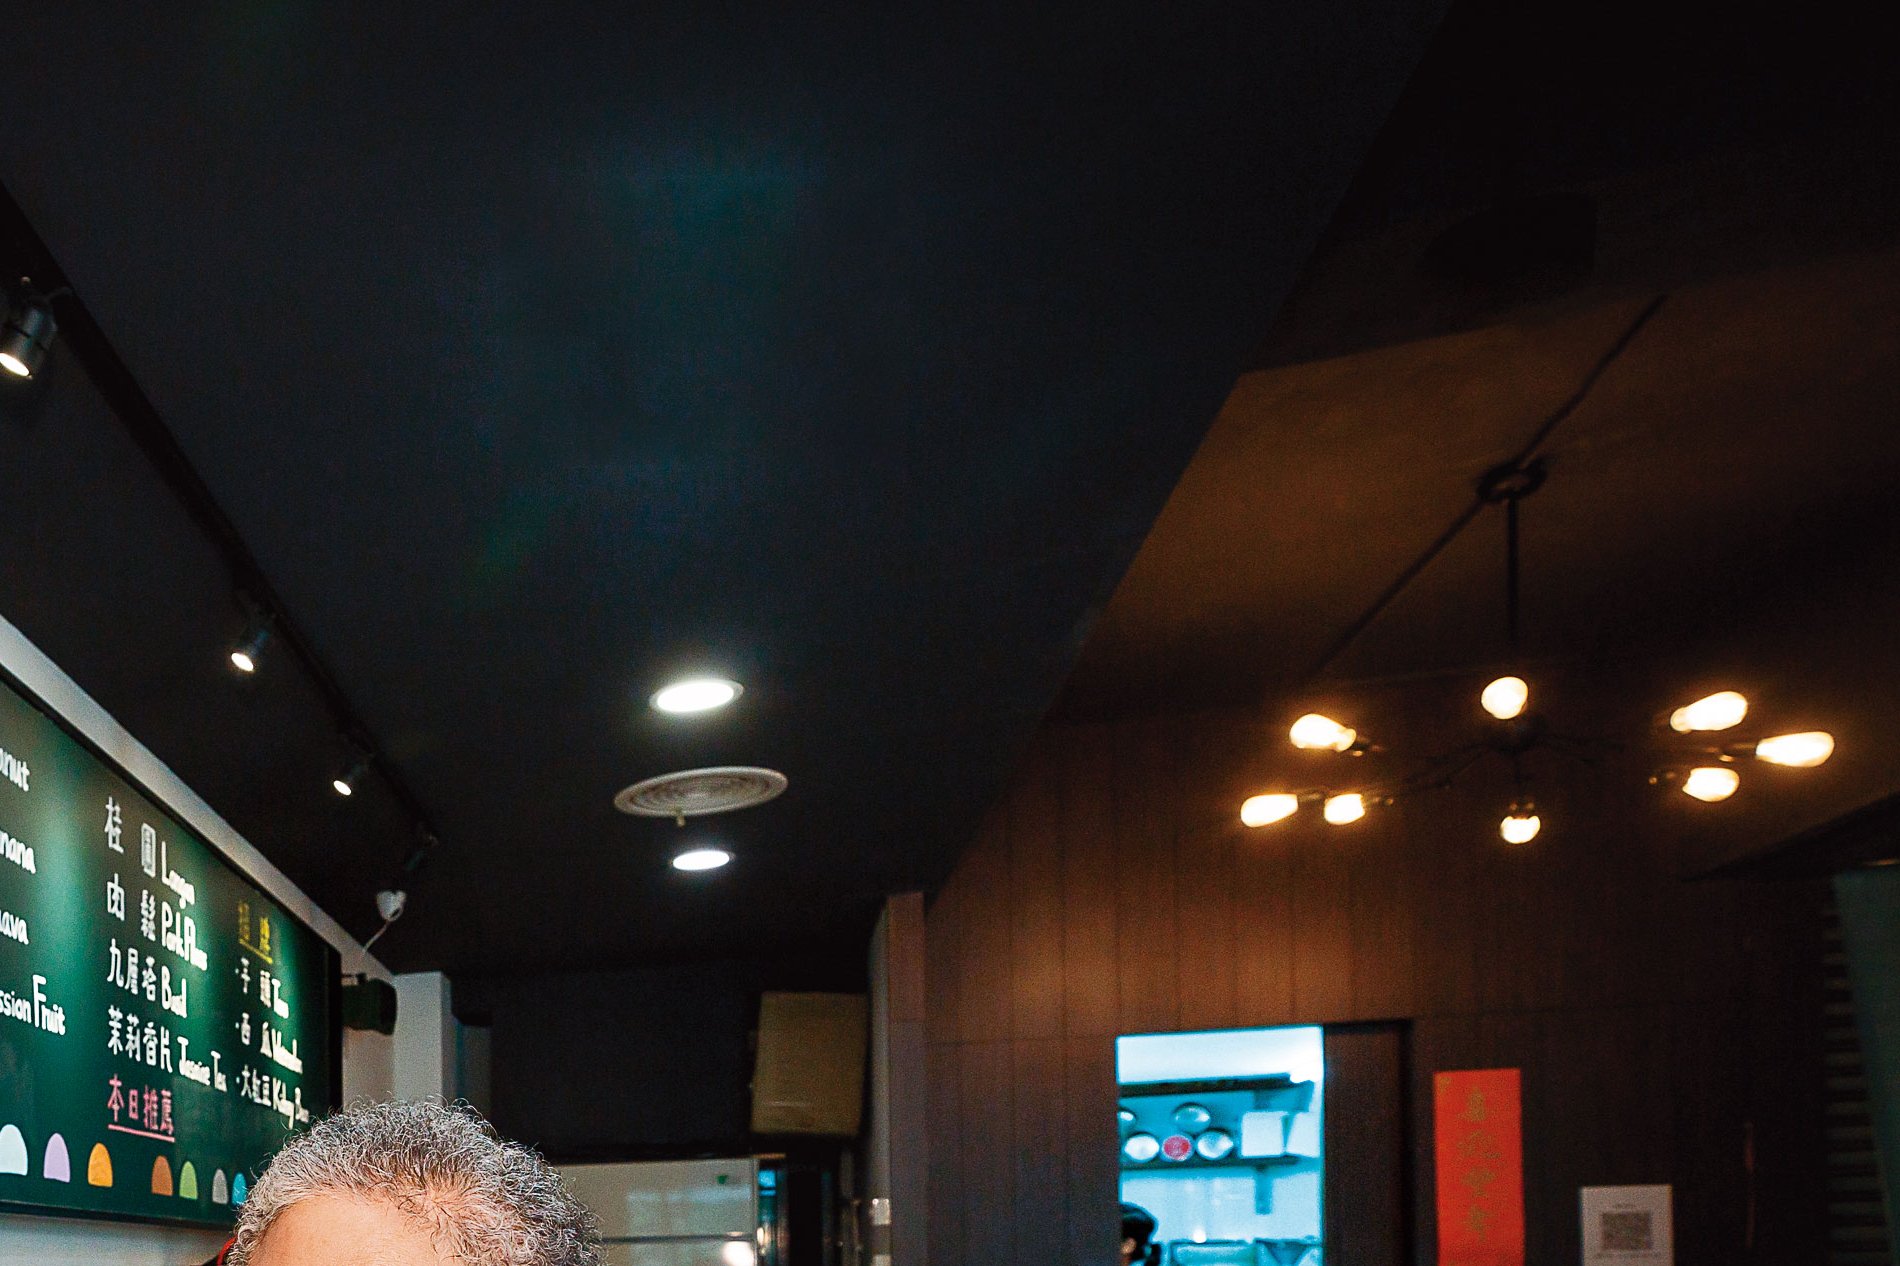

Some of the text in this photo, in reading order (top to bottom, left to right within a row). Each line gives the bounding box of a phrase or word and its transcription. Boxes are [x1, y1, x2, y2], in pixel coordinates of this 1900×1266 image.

[32, 974, 66, 1036] Fruit
[107, 1004, 173, 1074] 茉莉香片
